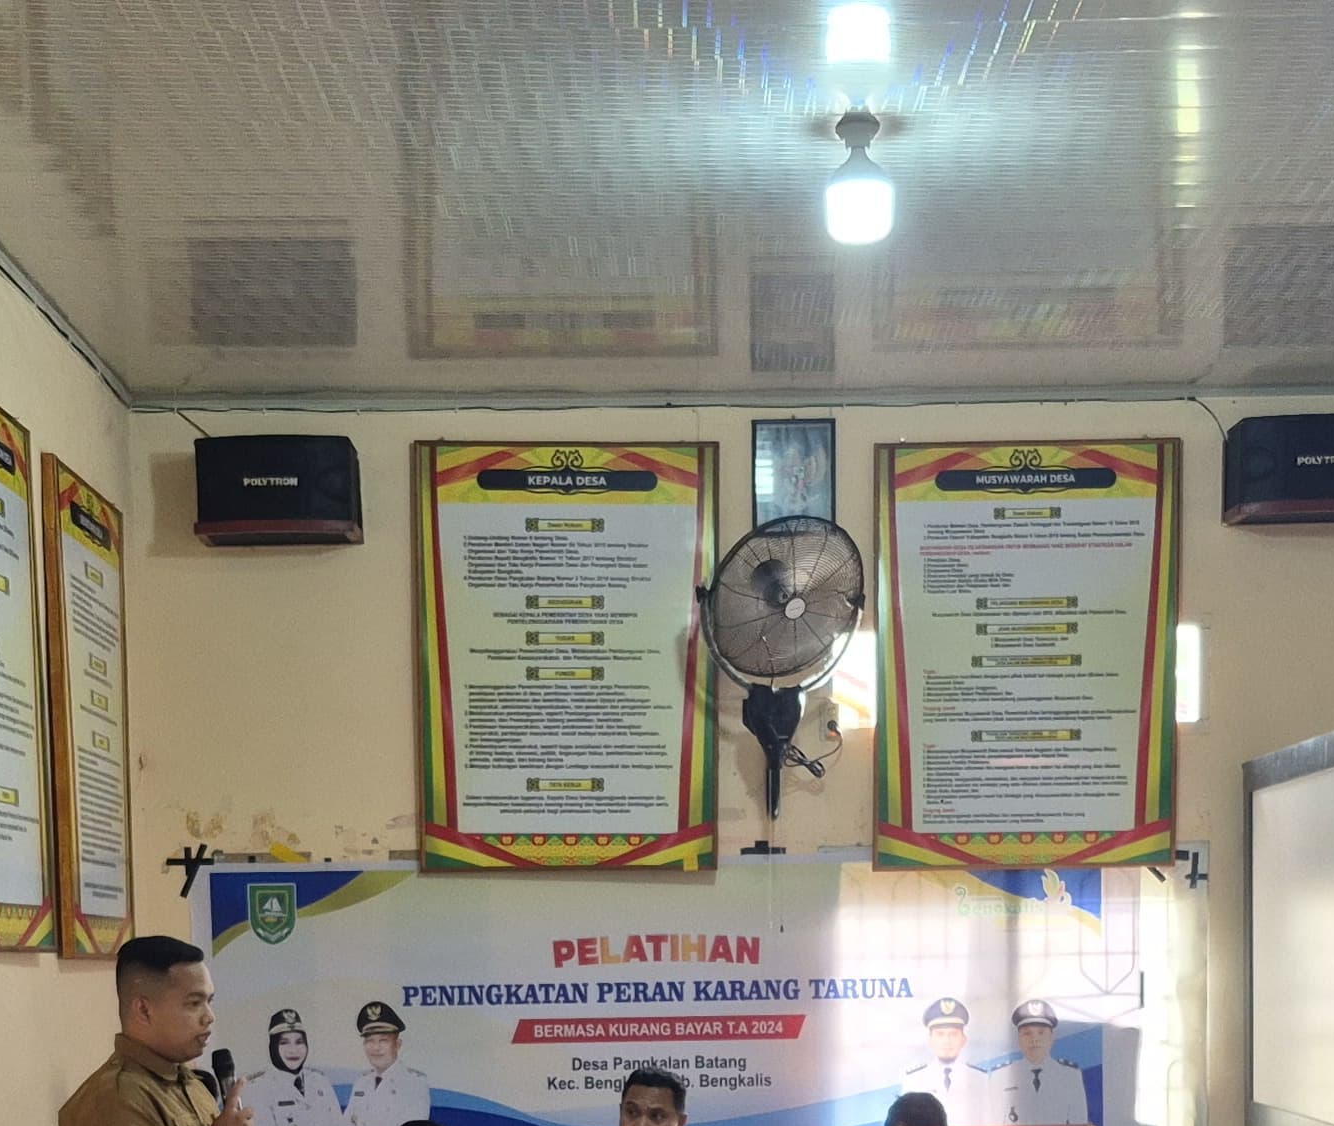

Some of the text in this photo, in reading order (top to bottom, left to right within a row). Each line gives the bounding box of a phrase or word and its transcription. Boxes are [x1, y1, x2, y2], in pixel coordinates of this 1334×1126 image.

[243, 476, 299, 488] POLYTRON
[527, 474, 607, 487] KEPALA DESA
[975, 473, 1076, 486] MUSYAWARAH DESA
[552, 933, 760, 968] PELATIHAN
[402, 977, 914, 1007] PENINGKATAN PERAN KARANG TARUNA
[533, 1020, 784, 1038] BERMASA KURANG BAYAR T.A 2024
[571, 1056, 608, 1072] Desa
[694, 1055, 747, 1072] Batang
[547, 1076, 580, 1091] Kec.
[699, 1073, 772, 1091] Bengkalis
